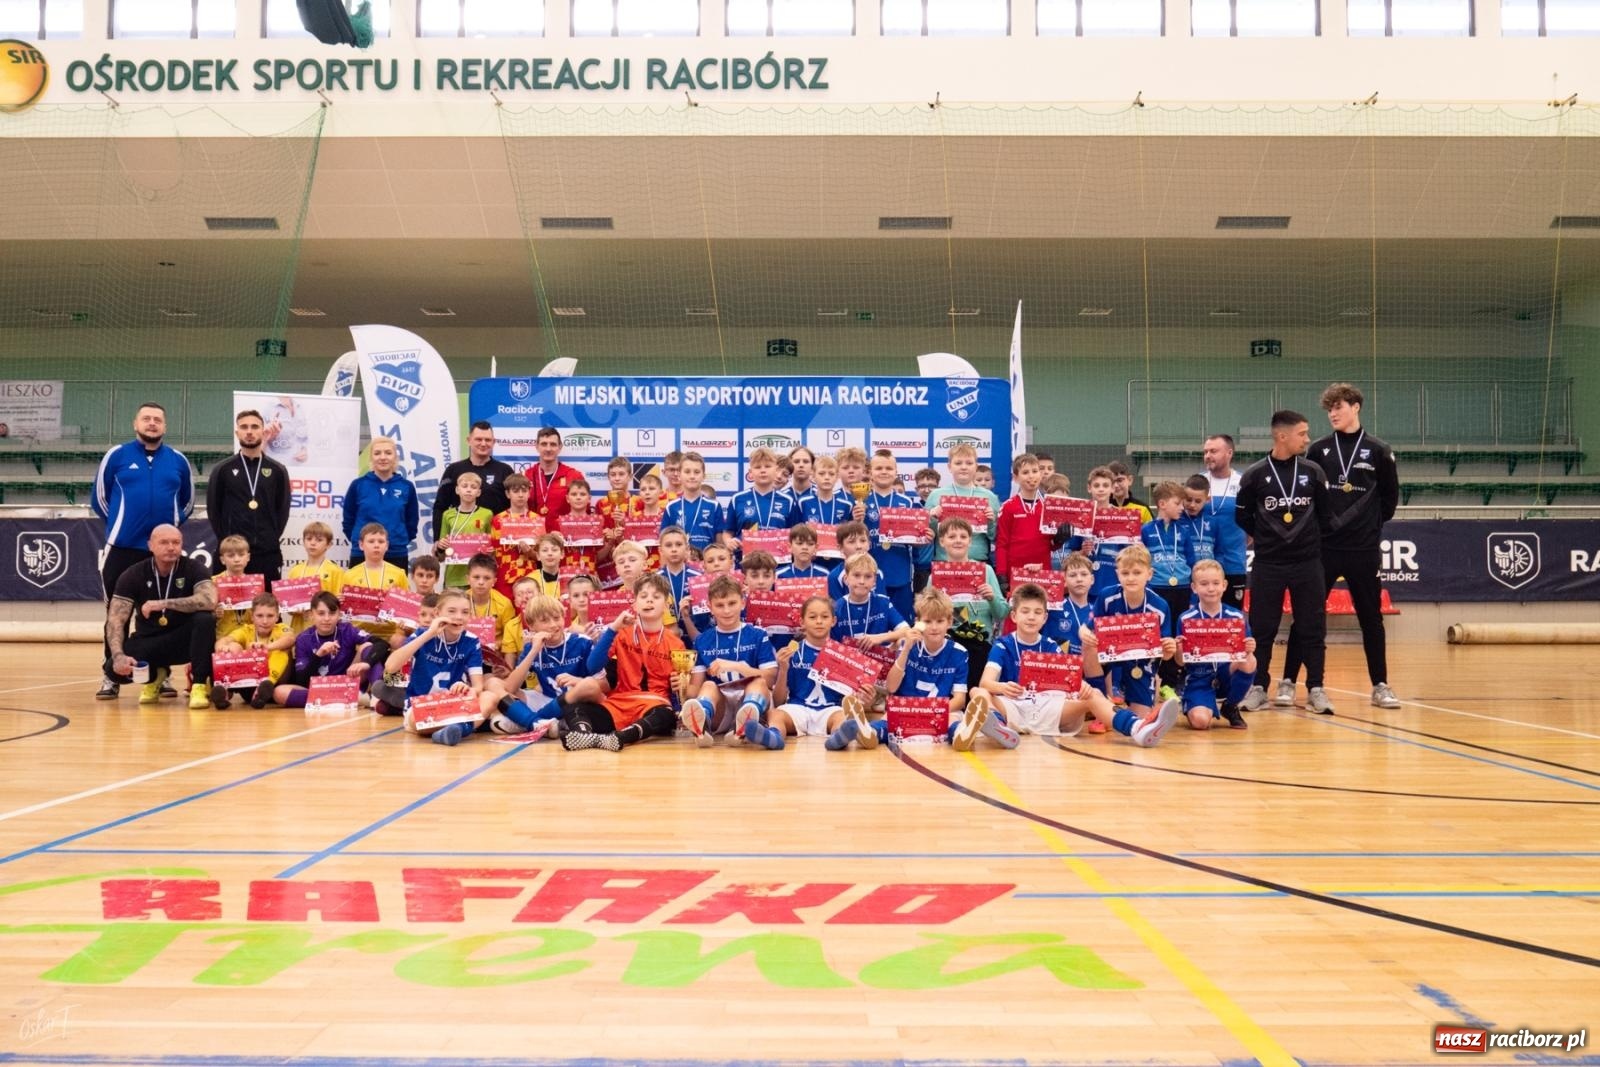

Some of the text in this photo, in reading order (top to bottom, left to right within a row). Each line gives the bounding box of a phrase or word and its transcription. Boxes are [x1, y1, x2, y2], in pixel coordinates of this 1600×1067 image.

[66, 51, 830, 92] OŚRODEK SPORTU I REKREACJI RACIBÓRZ
[555, 382, 928, 406] MIEJSKI KLUB SPORTOWY UNIA RACIBÓRZ
[949, 394, 976, 410] UNIA
[498, 404, 544, 414] Racibórz
[562, 439, 612, 447] GROTEAM
[290, 480, 332, 494] PRO
[100, 868, 1017, 925] RAFAKO
